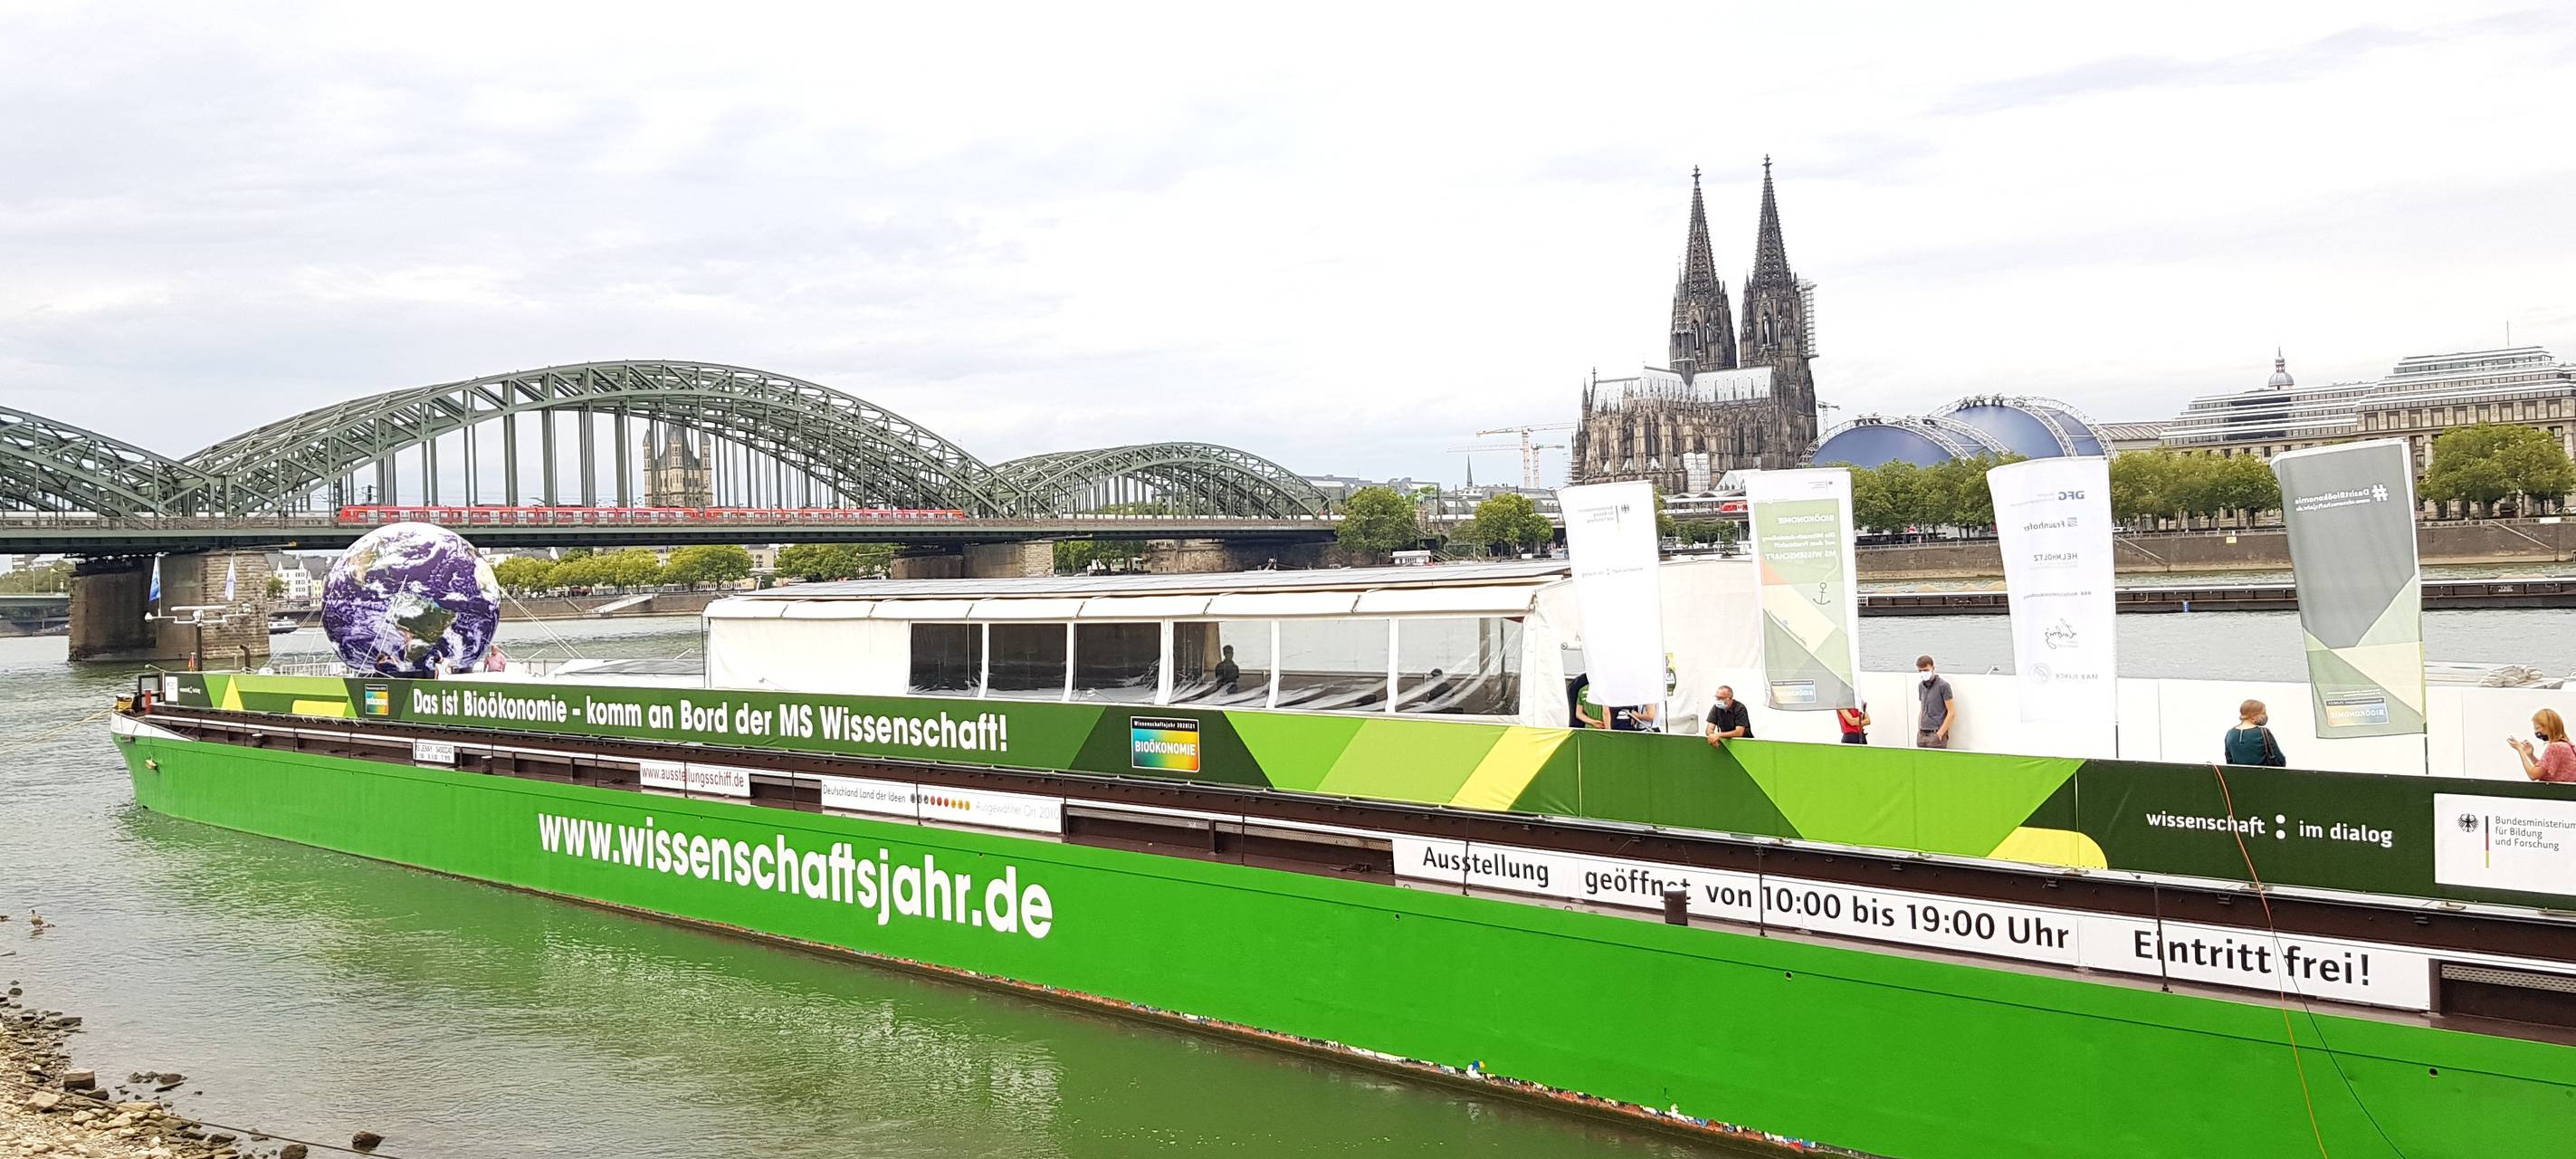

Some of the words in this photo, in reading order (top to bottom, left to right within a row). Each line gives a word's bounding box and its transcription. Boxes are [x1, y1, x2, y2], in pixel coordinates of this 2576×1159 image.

[413, 688, 438, 715] Das
[441, 690, 459, 716] ist
[463, 690, 568, 723] Bioökonomie
[572, 708, 581, 716] -
[587, 695, 643, 727] komm
[648, 703, 673, 729] an
[681, 700, 728, 733] Bord
[735, 703, 772, 735] der
[779, 704, 813, 738] MS
[819, 705, 1007, 752] Wissenschaft!
[1134, 739, 1196, 756] BIOÖKONOMIE
[823, 784, 859, 798] Deutschland
[860, 788, 874, 800] Land
[876, 790, 886, 800] der
[889, 790, 906, 803] Ideen
[2146, 810, 2266, 838] wissenschaft
[2299, 820, 2323, 838] im
[2330, 822, 2393, 848] dialog
[2495, 827, 2507, 836] für
[2509, 827, 2543, 840] Bildung
[2495, 838, 2512, 847] und
[2514, 838, 2560, 852] Forschung
[538, 812, 1054, 940] www.wissenschaftsjahr.de
[1422, 846, 1549, 888] Ausstellung
[1585, 867, 1692, 899] geöffnt
[1704, 885, 1752, 908] von
[1762, 886, 1841, 919] 10:00
[1852, 895, 1895, 927] bis
[1906, 904, 1995, 940] 19:00
[2008, 915, 2069, 949] Uhr
[2134, 929, 2272, 974] Eintritt
[2284, 945, 2369, 986] frei!
